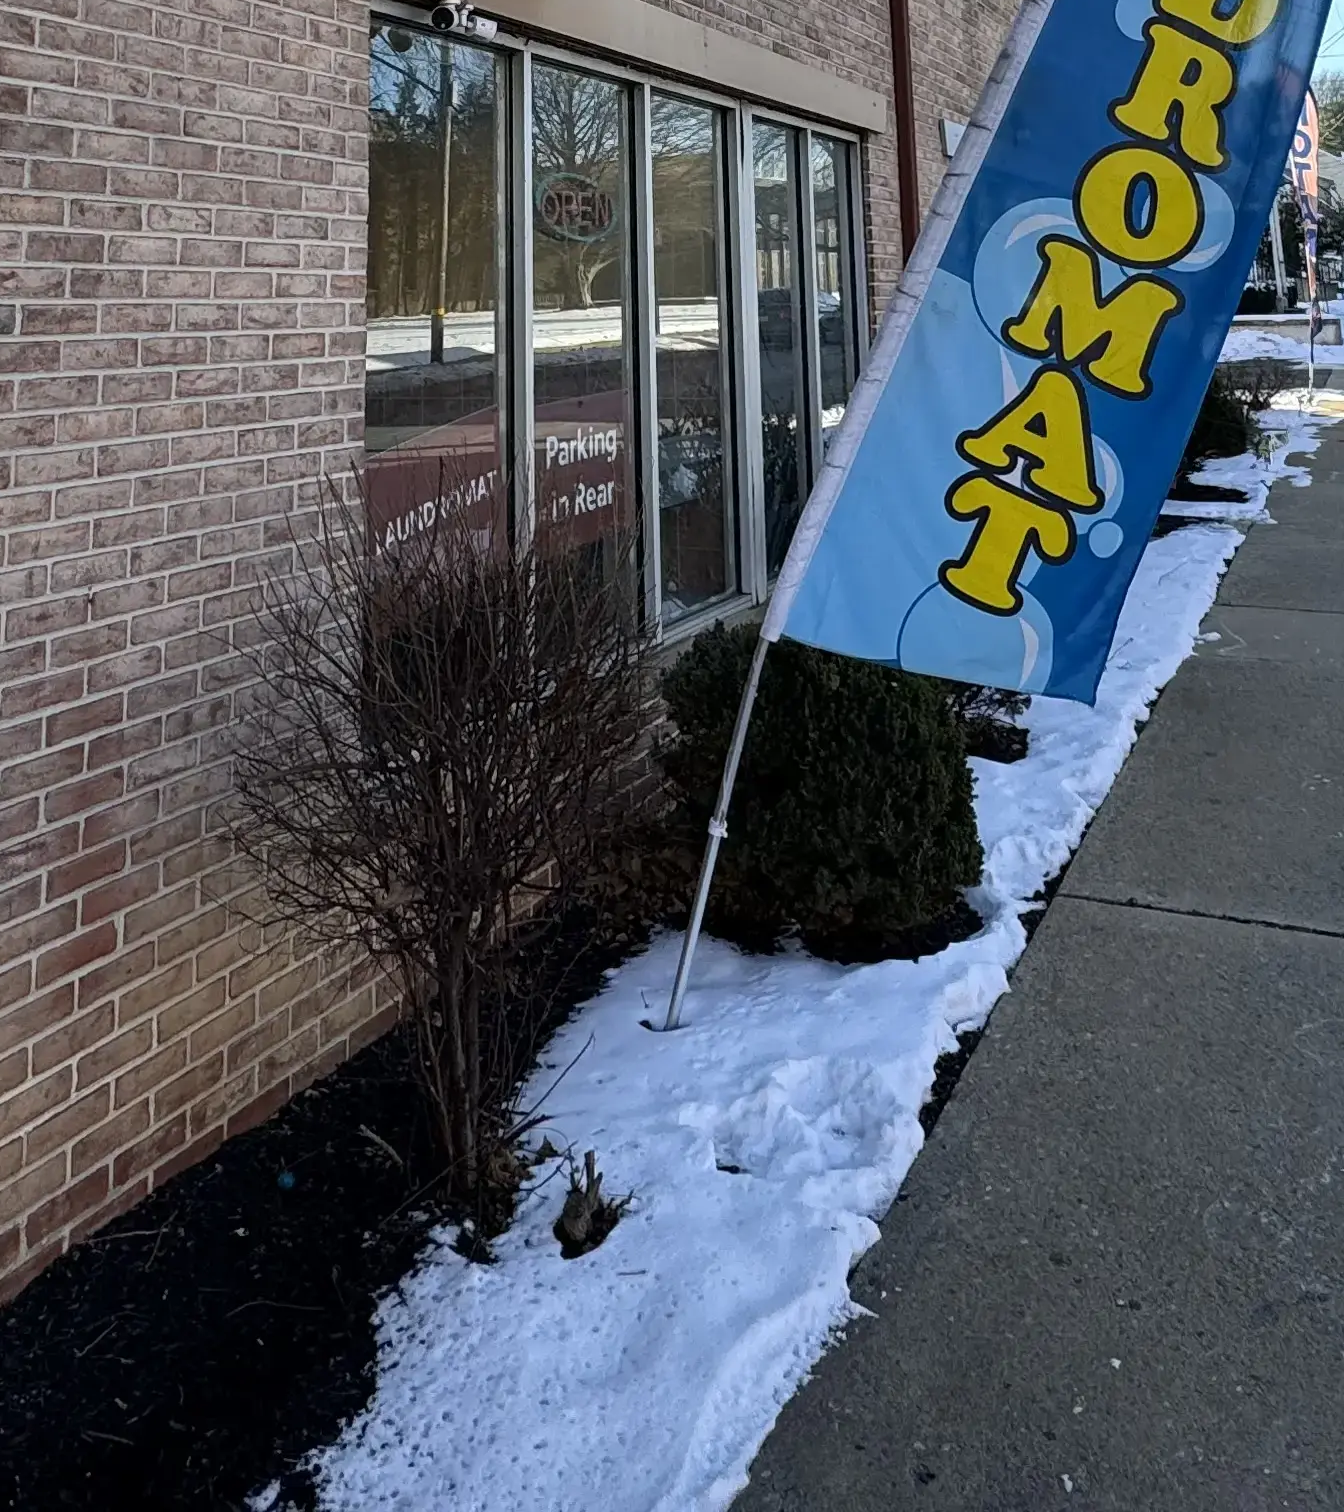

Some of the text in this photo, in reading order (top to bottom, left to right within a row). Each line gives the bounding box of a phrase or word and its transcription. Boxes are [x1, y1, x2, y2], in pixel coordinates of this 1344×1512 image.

[541, 188, 610, 228] OPEN
[545, 426, 618, 470] Parking
[574, 480, 616, 516] Rear
